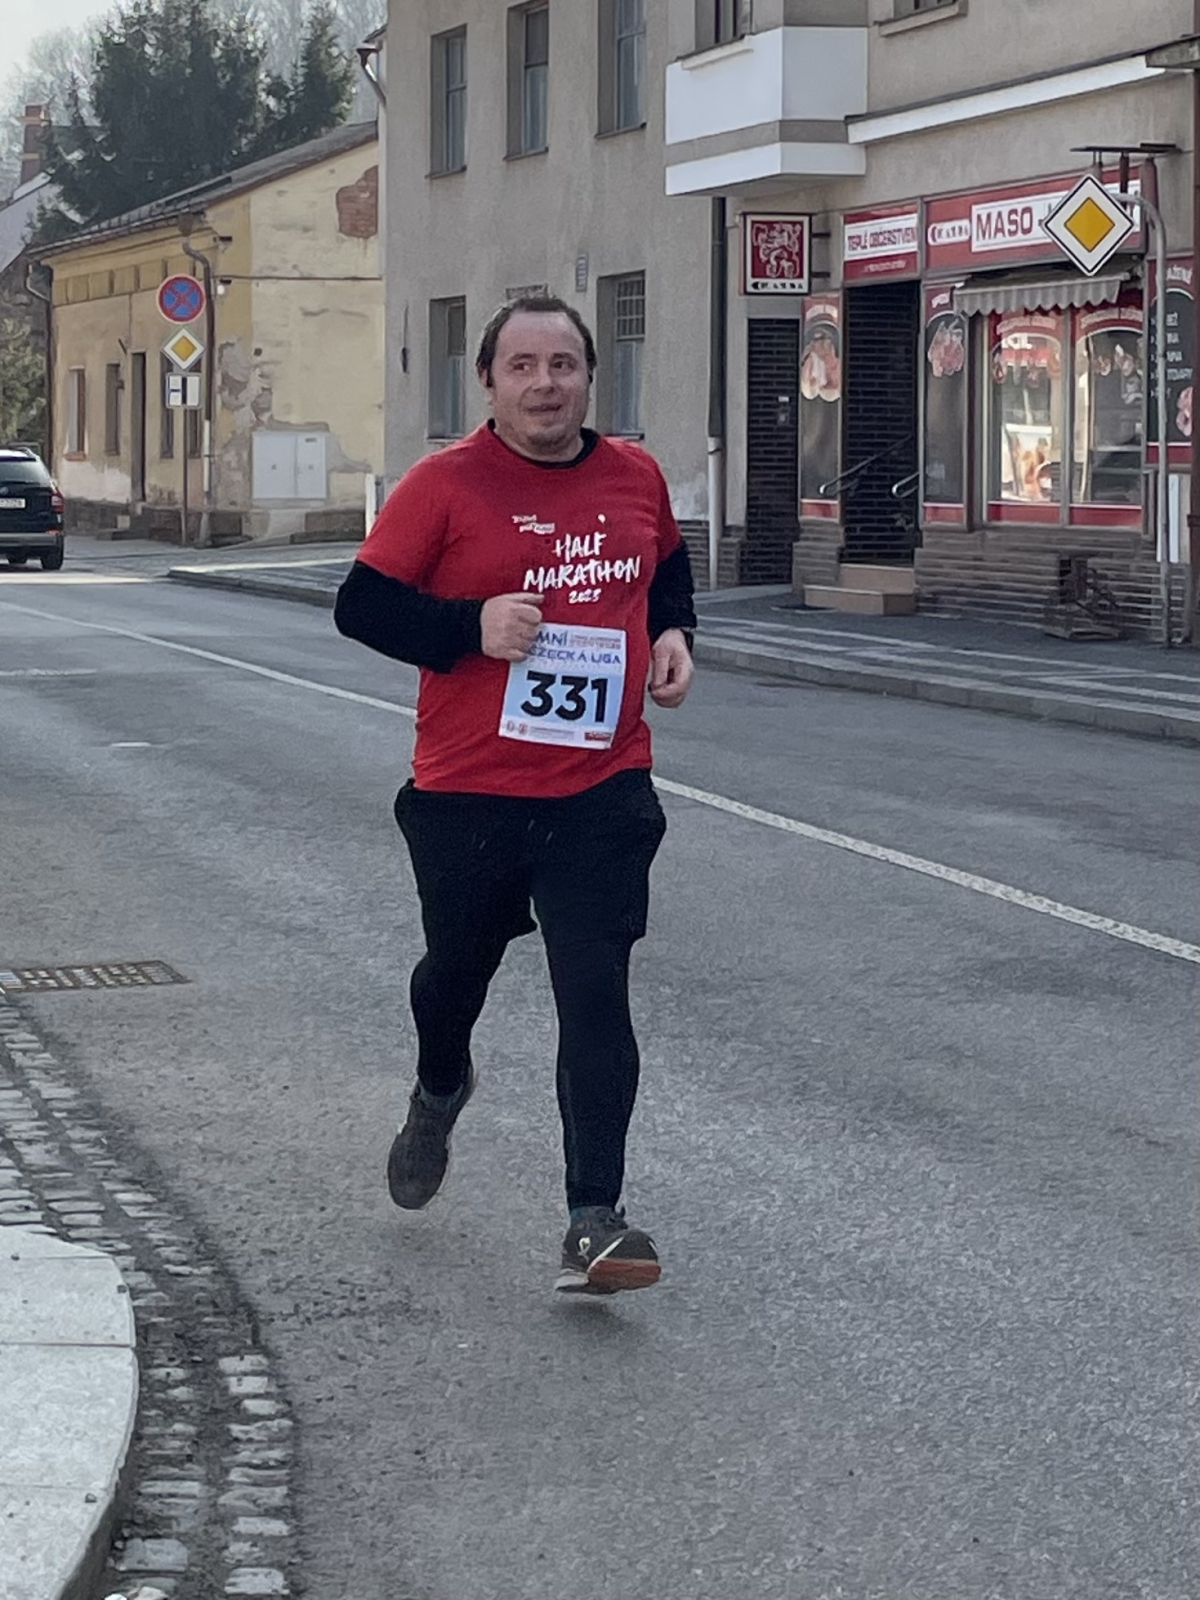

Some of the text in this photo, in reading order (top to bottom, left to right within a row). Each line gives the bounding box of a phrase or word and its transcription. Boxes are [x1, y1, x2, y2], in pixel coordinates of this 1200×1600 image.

[976, 206, 1034, 241] MASO
[552, 531, 607, 564] HALF
[523, 555, 641, 593] MARATHON
[536, 630, 568, 646] MNÍ
[521, 670, 608, 723] 331
